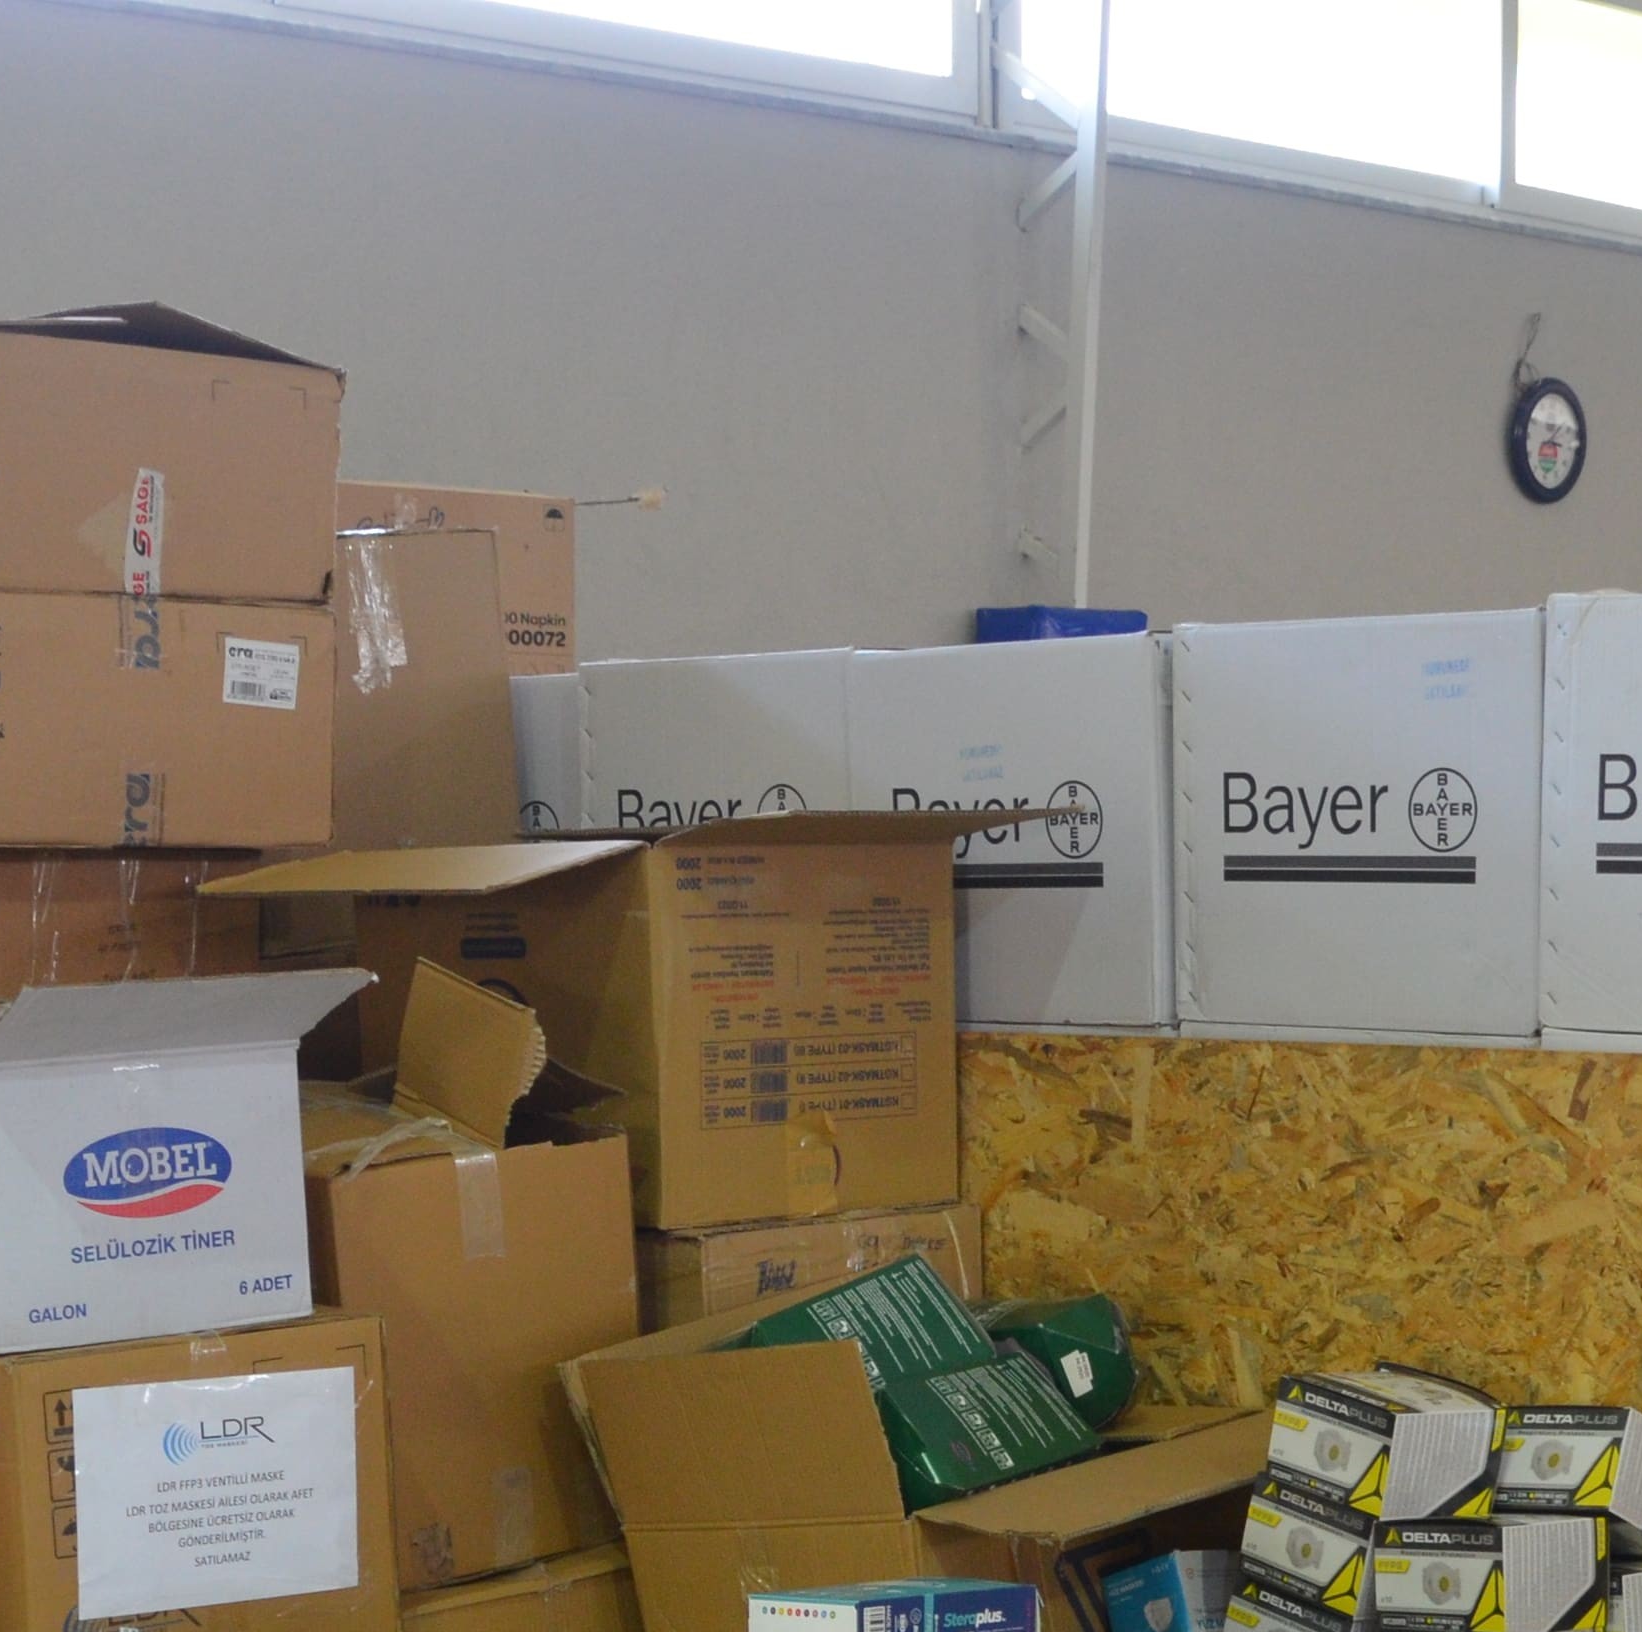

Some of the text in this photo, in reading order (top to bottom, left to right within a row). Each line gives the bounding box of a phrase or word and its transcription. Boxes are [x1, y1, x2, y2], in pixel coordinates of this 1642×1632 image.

[520, 611, 567, 633] Napkin
[506, 630, 567, 648] 00072
[228, 645, 254, 660] era
[1221, 771, 1390, 850] Bayer
[1412, 802, 1475, 818] BAYER
[1436, 772, 1450, 848] BAYER
[83, 1142, 217, 1188] MOBEL
[70, 1229, 236, 1264] SELÜLOZİK TİNER
[238, 1274, 293, 1296] 6 ADET
[28, 1303, 88, 1325] GALON
[1304, 1391, 1388, 1430] DELTAPLUS
[1522, 1413, 1620, 1426] DELTAPLUS
[200, 1415, 276, 1445] LDR
[156, 1480, 177, 1494] LDR
[179, 1478, 204, 1492] FFP3
[250, 1469, 286, 1484] MASKE
[125, 1505, 147, 1518] LDR
[148, 1503, 170, 1516] TOZ
[250, 1490, 289, 1505] OLARAK
[290, 1487, 315, 1501] AFET
[1279, 1488, 1366, 1531] DELTAPLUS
[255, 1508, 296, 1523] OLARAK
[1401, 1531, 1495, 1546] DELTAPLUS
[194, 1550, 252, 1568] SATILAMAZ
[943, 1608, 1006, 1629] Steraplus
